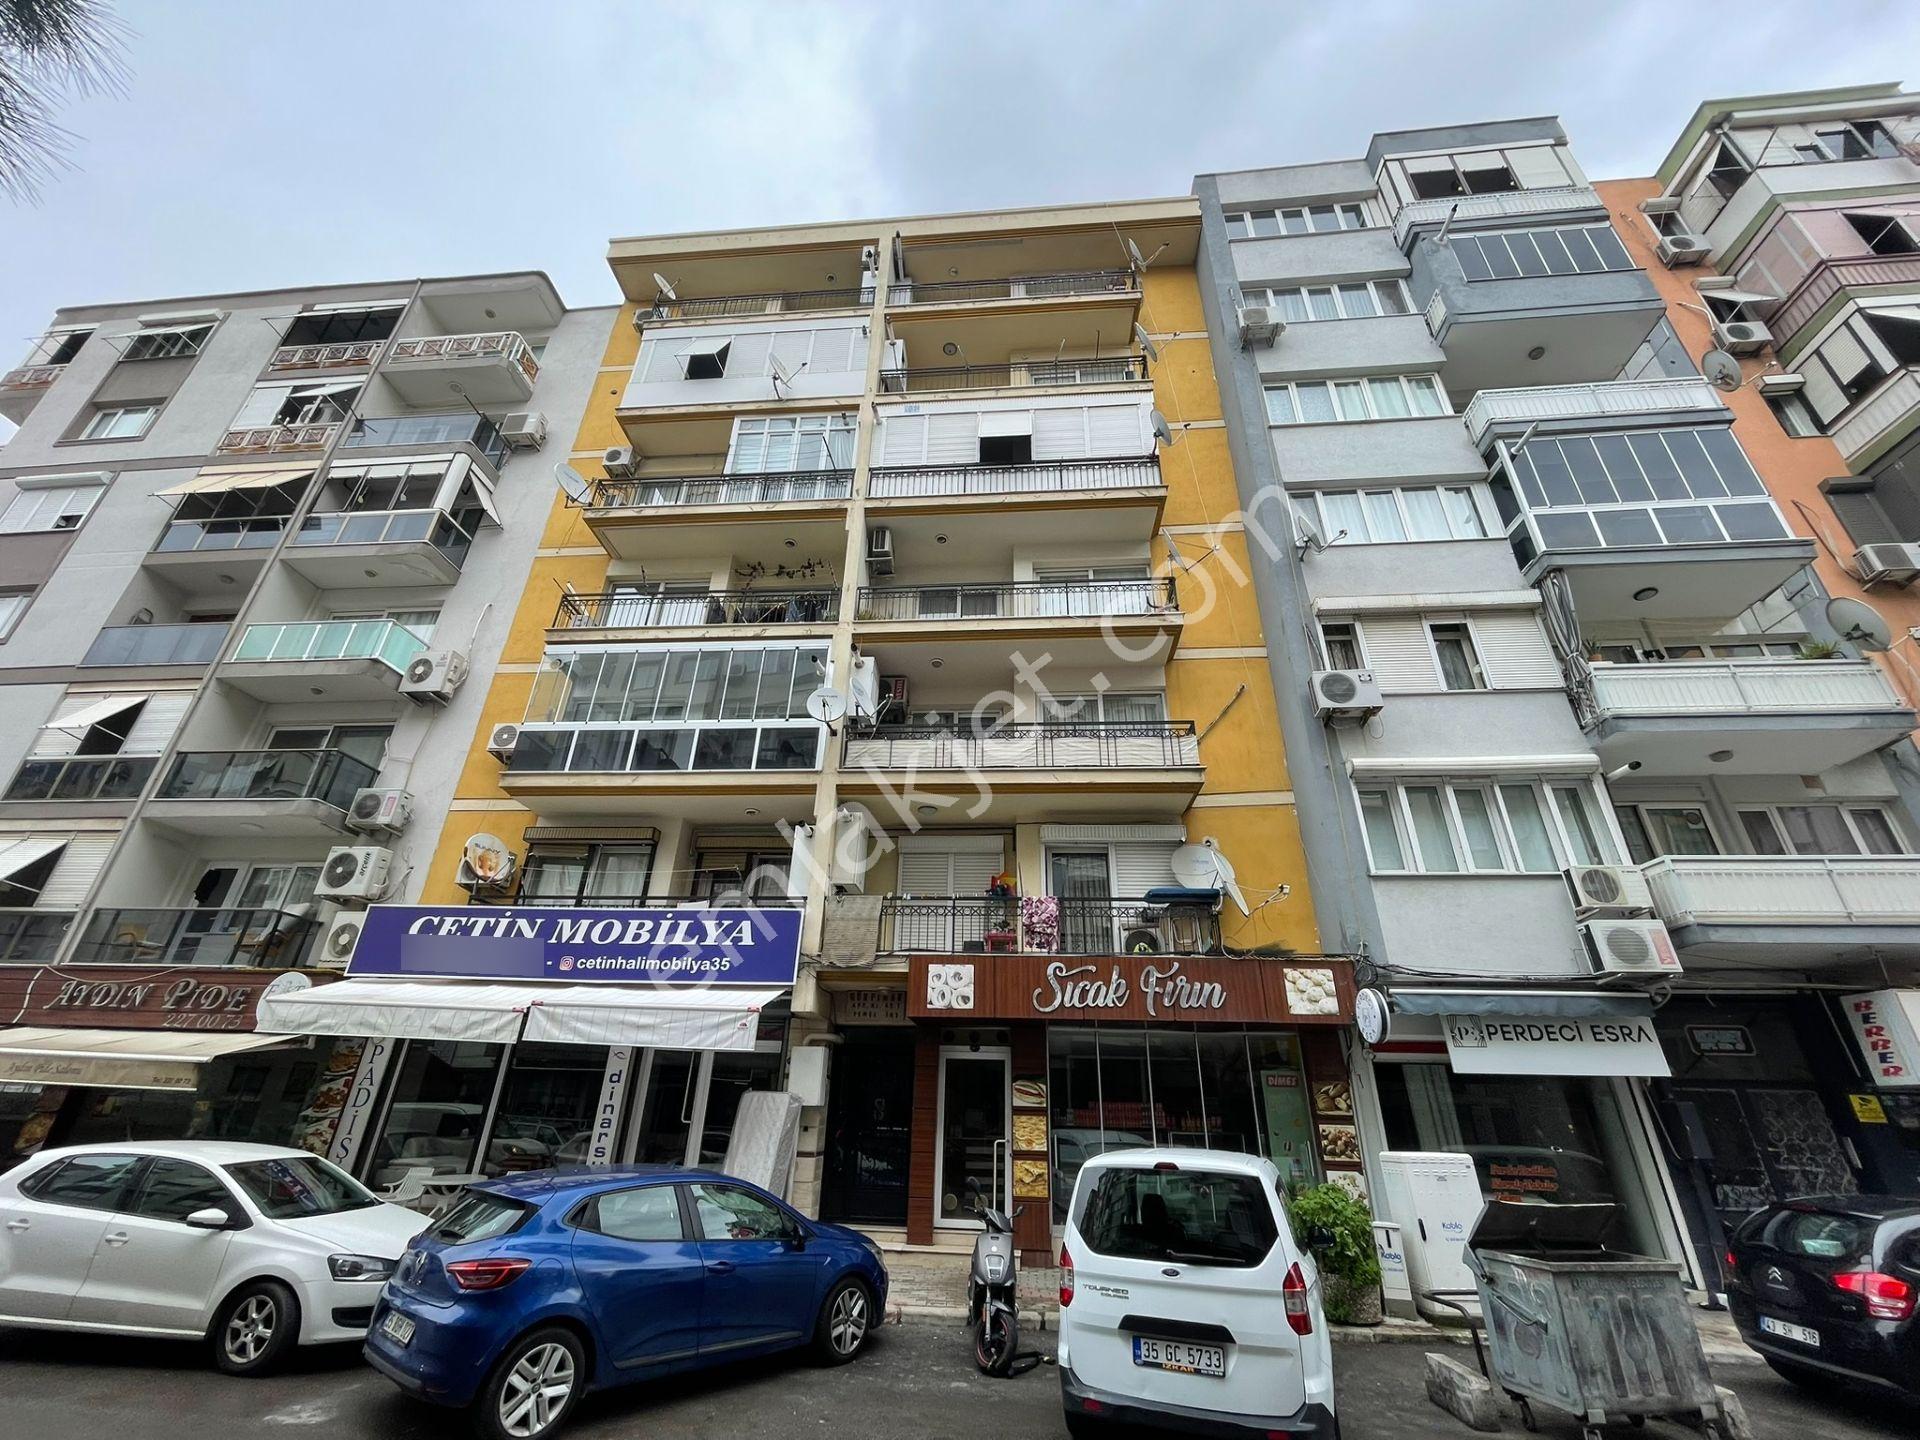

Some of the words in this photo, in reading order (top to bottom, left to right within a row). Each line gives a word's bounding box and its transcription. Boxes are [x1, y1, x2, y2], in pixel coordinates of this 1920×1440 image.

[547, 912, 755, 946] MOBİLYA
[577, 957, 731, 974] cetinhalimobilya35
[43, 981, 154, 1009] AYDIN
[1032, 961, 1130, 1013] Sıcak
[1139, 961, 1227, 1017] Fırın
[1485, 1021, 1583, 1042] PERDECİ
[1591, 1025, 1653, 1043] ESRA
[1853, 1000, 1903, 1077] BERBER
[592, 1069, 623, 1166] dinars
[1143, 1341, 1159, 1360] 35
[1165, 1344, 1181, 1363] GC
[1187, 1347, 1221, 1369] 5733
